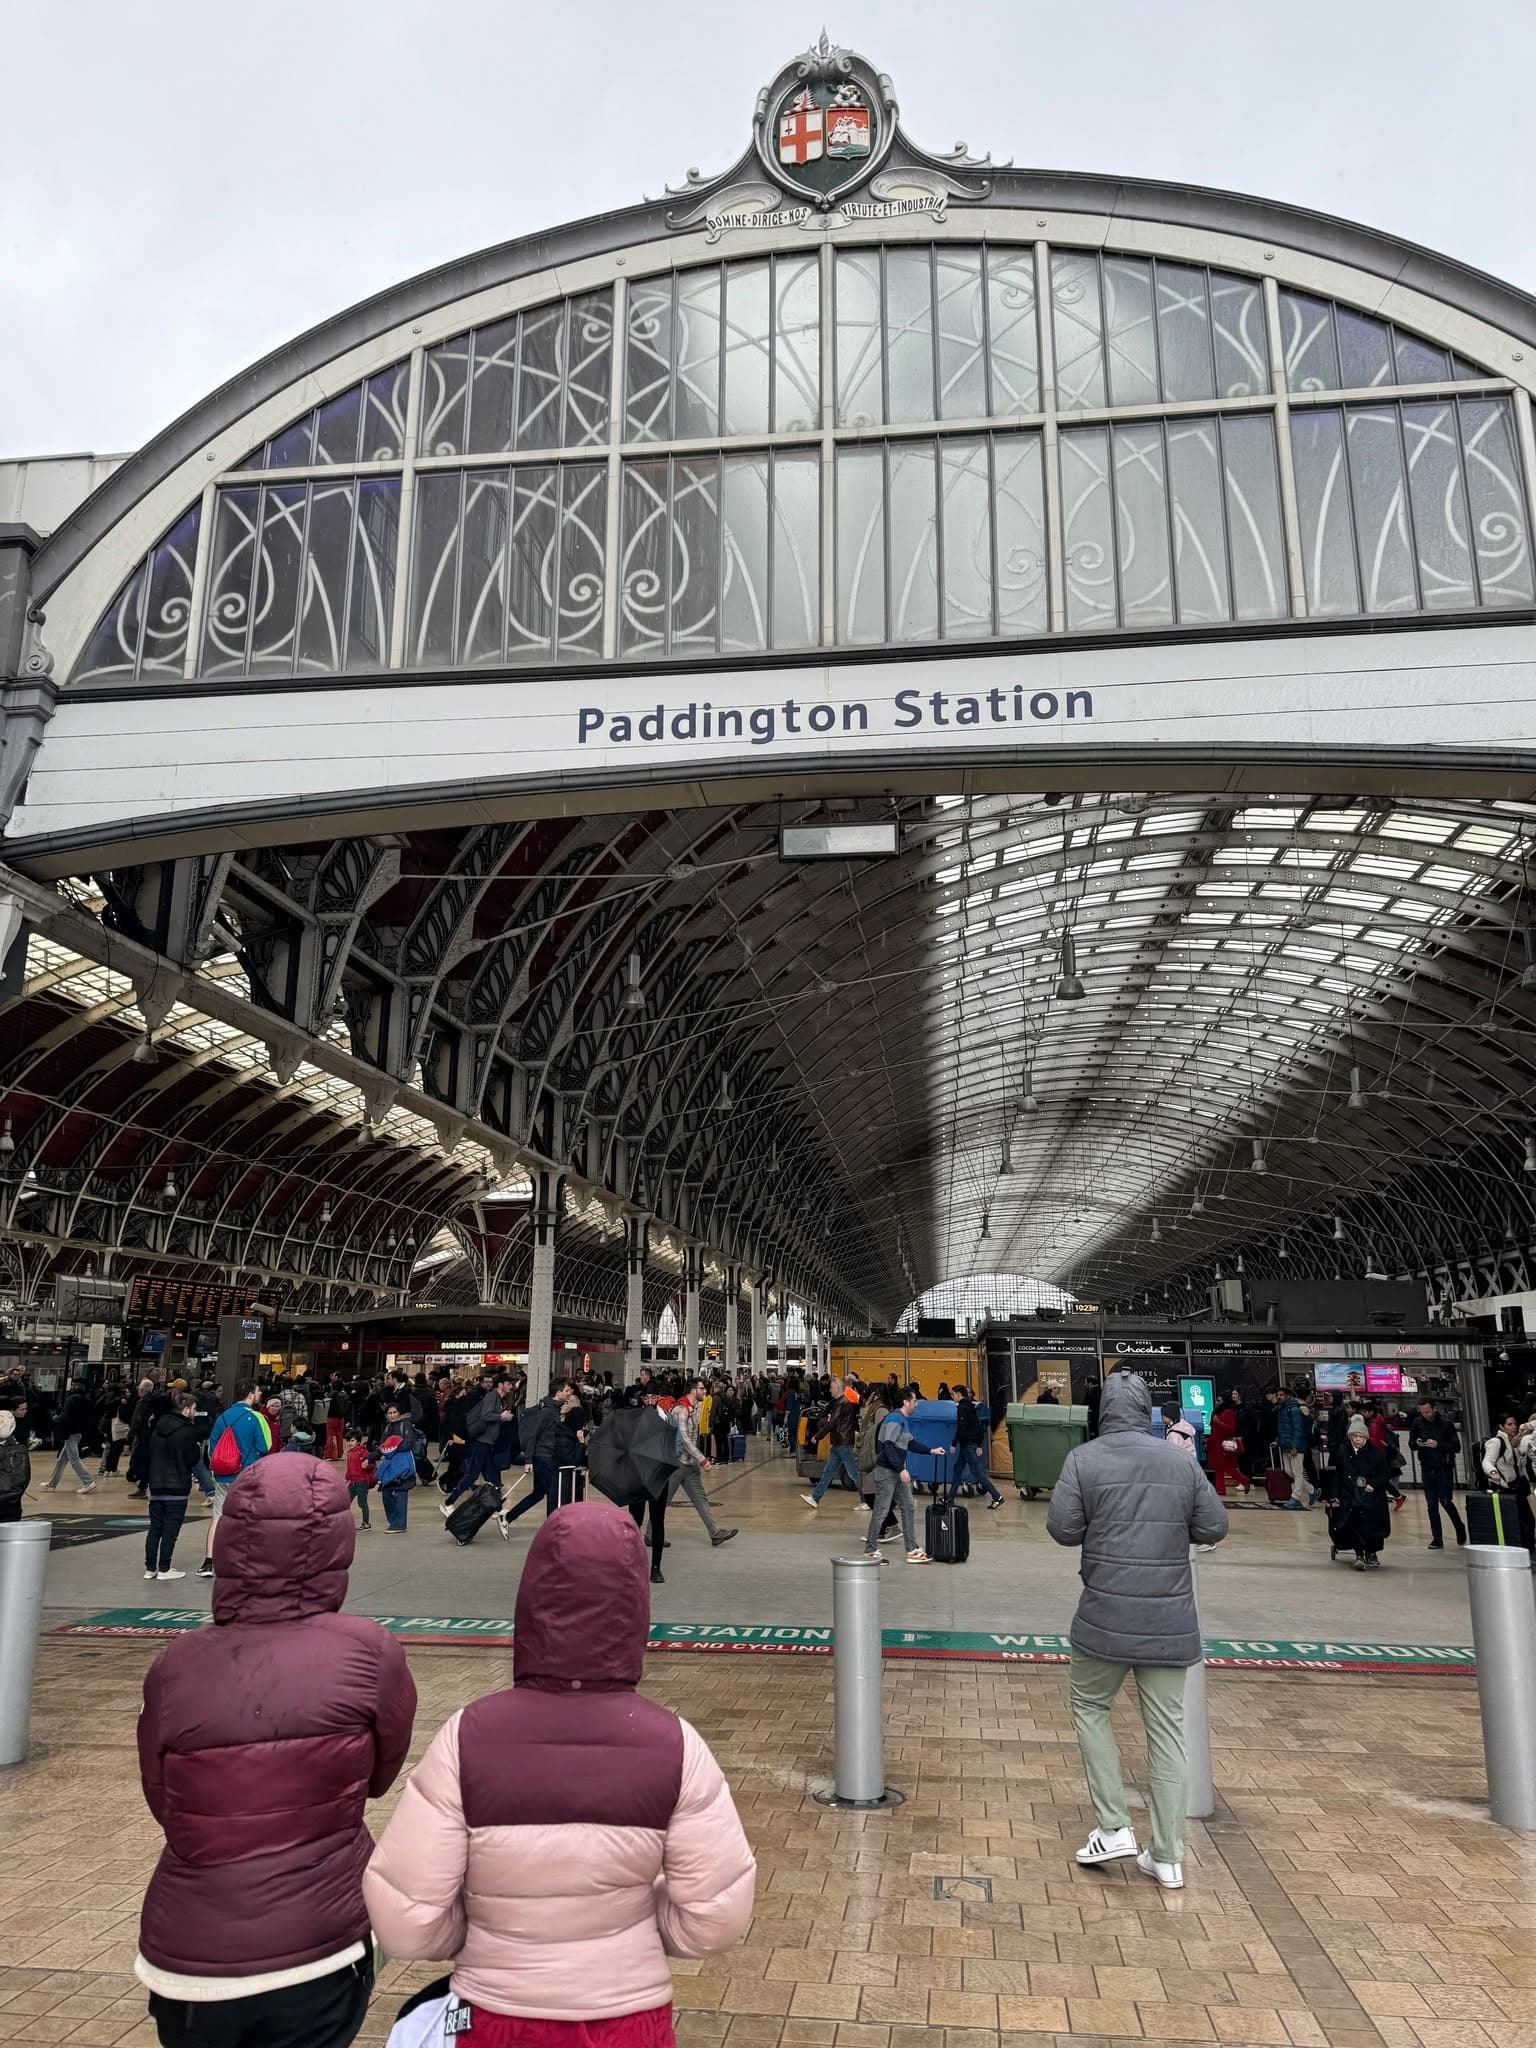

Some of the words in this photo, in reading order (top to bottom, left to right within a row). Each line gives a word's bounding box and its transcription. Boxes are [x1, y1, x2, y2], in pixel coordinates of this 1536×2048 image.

[841, 204, 877, 216] VIRTUTE
[883, 204, 892, 216] ET
[898, 197, 945, 213] INDUSTRIA
[708, 215, 746, 229] DOMINE
[789, 208, 807, 221] NOS
[578, 699, 868, 745] Paddington
[894, 685, 1094, 728] Station
[104, 1626, 193, 1634] SMOKIN
[668, 1625, 832, 1640] STATION
[732, 1643, 831, 1652] CYCLING
[1218, 1641, 1279, 1653] TO
[1291, 1643, 1476, 1659] PADDIN
[1233, 1658, 1343, 1668] CYCLING
